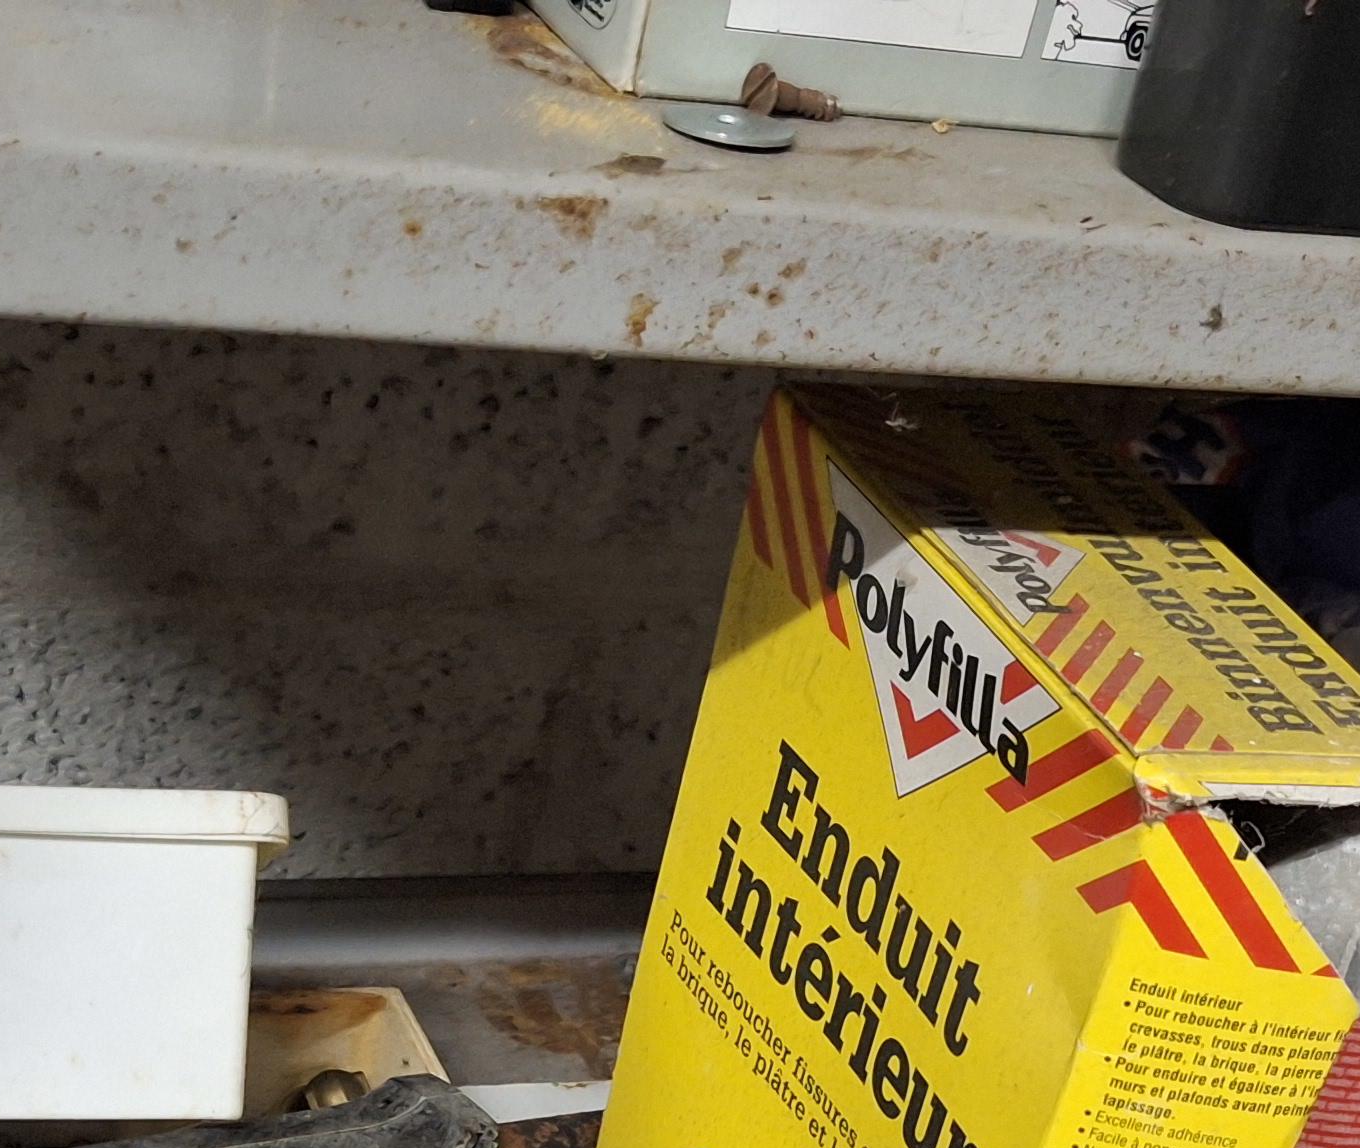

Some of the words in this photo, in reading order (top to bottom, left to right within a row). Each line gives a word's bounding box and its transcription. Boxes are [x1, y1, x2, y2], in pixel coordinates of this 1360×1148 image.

[827, 509, 1029, 784] Polyfilla
[761, 739, 982, 1057] Enduit
[669, 908, 707, 967] Pour
[706, 959, 792, 1066] reboucher
[1128, 977, 1178, 1001] Enduit
[1179, 989, 1244, 1012] intérieur
[660, 932, 675, 967] la
[676, 954, 730, 1040] brique,
[733, 1024, 752, 1058] le
[751, 1051, 806, 1122] plâtre
[808, 1117, 828, 1148] et
[1134, 999, 1171, 1020] Pour
[1172, 1010, 1247, 1033] reboucher
[1248, 1019, 1259, 1034] à
[1261, 1021, 1332, 1042] l'intérieur
[1121, 1037, 1138, 1054] le
[1192, 1052, 1207, 1066] la
[1264, 1061, 1279, 1077] la
[1210, 1035, 1248, 1053] trous
[1250, 1040, 1286, 1058] dans
[1108, 1076, 1147, 1095] murs
[1149, 1085, 1166, 1098] et
[1165, 1088, 1230, 1110] plafonds
[1231, 1099, 1272, 1114] avant
[1114, 1055, 1150, 1076] Pour
[1152, 1067, 1208, 1086] enduire
[1210, 1075, 1226, 1089] et
[1228, 1076, 1288, 1097] égaliser
[1288, 1083, 1298, 1097] à
[1087, 1126, 1128, 1148] Facile
[1094, 1109, 1165, 1137] Excellente
[1166, 1127, 1238, 1148] adhérence
